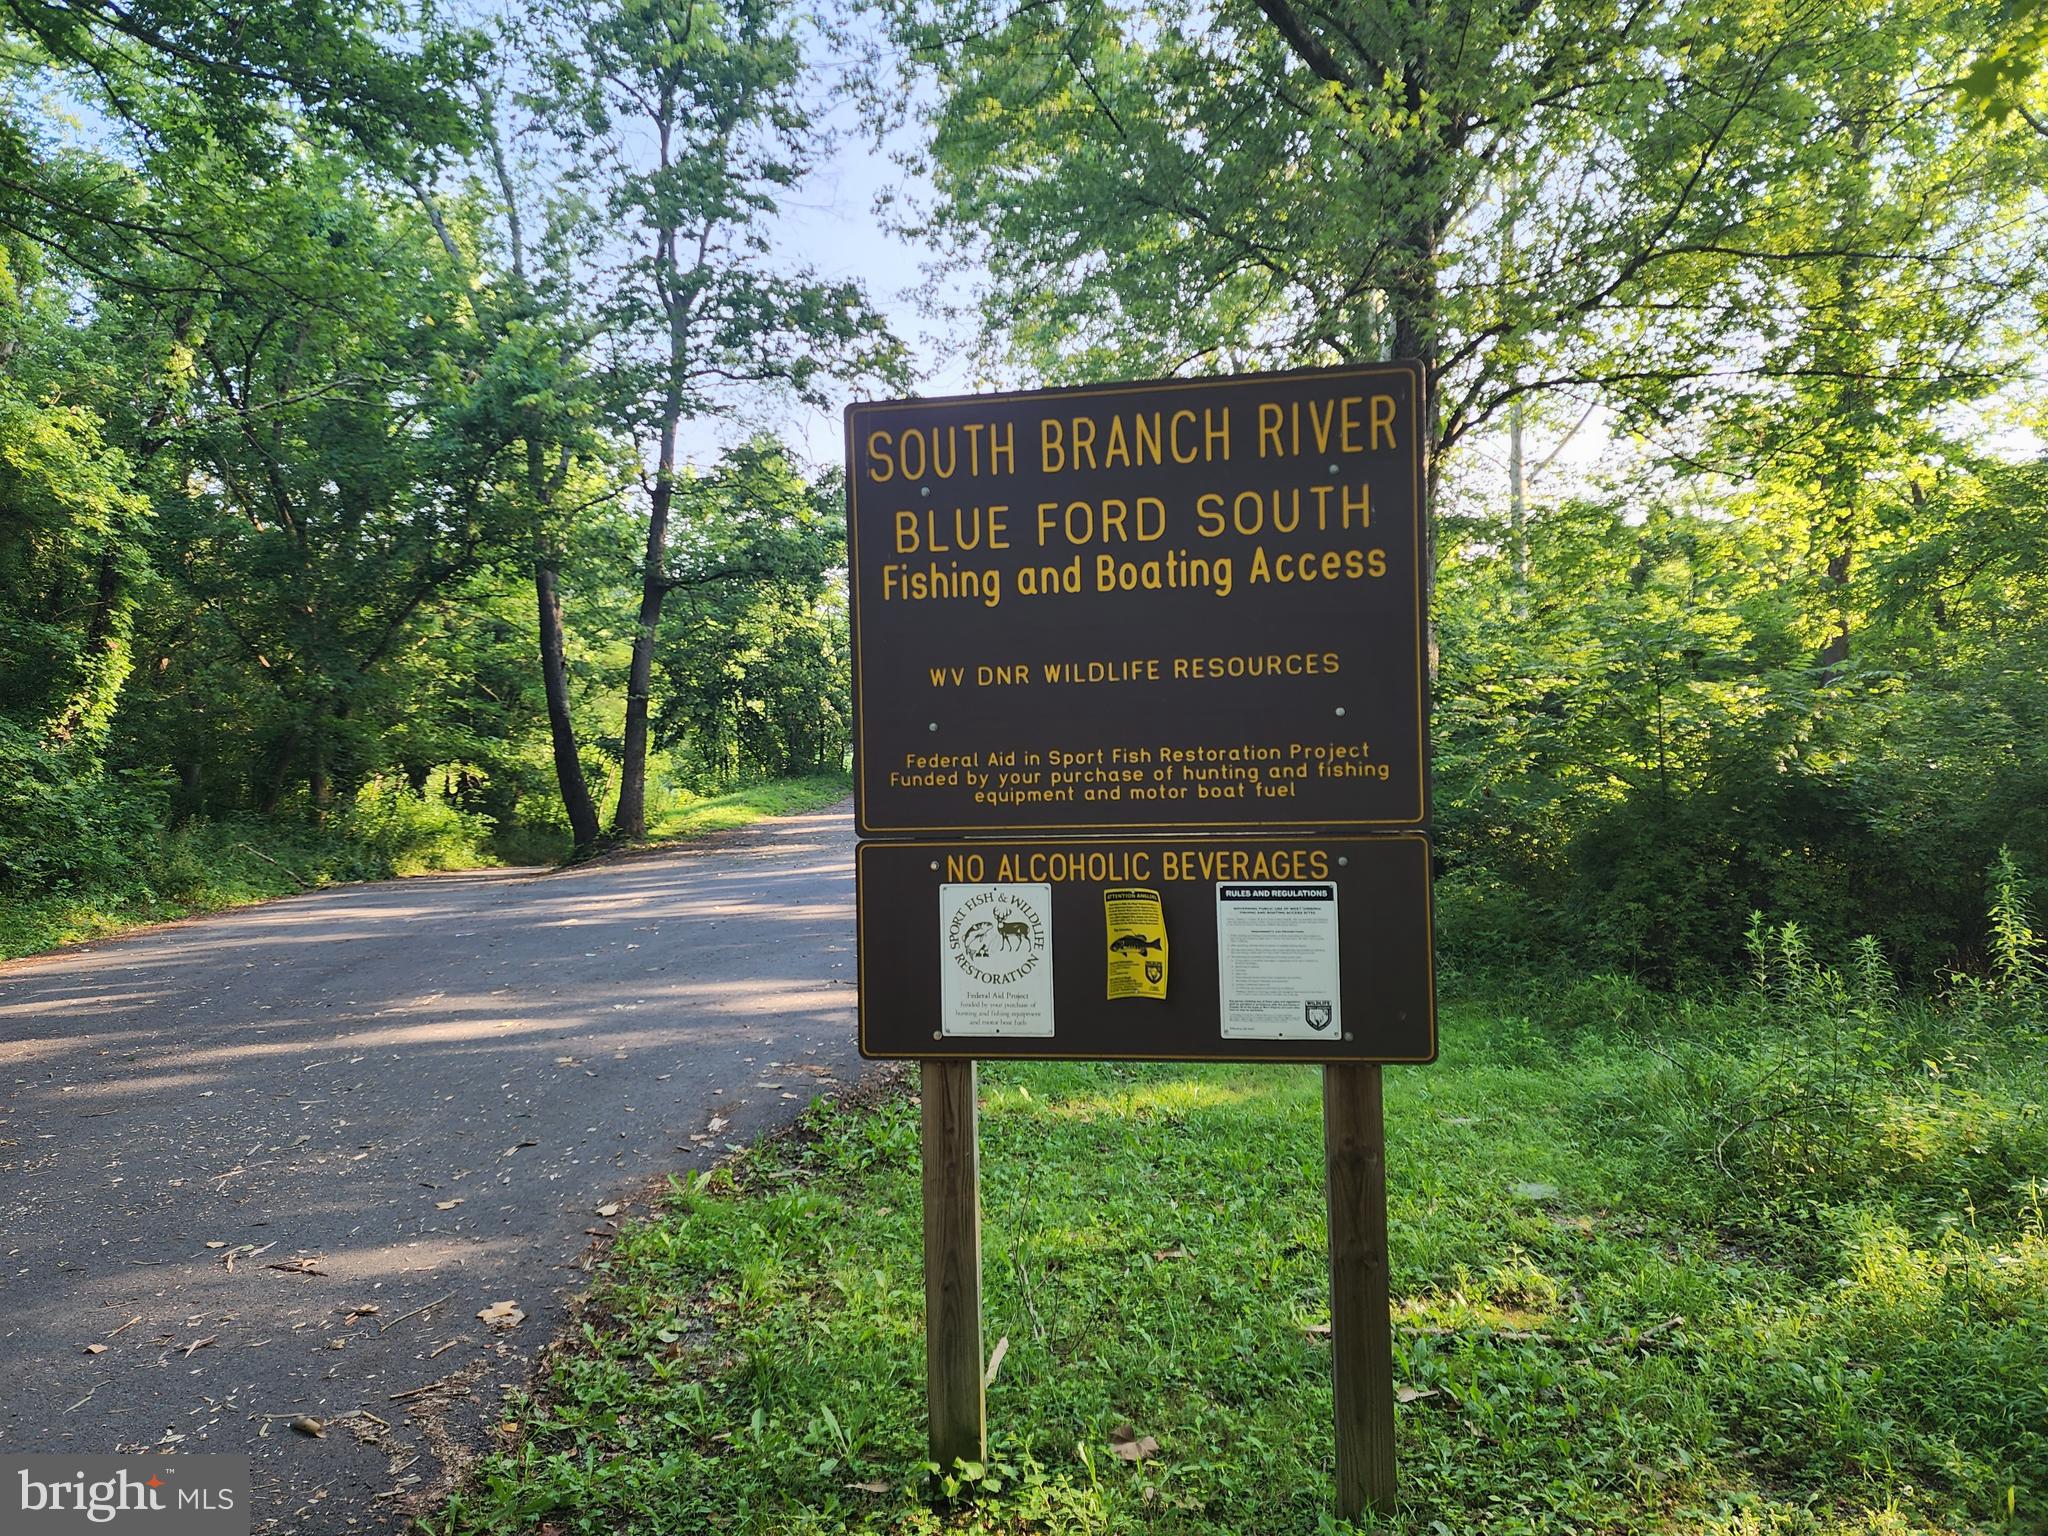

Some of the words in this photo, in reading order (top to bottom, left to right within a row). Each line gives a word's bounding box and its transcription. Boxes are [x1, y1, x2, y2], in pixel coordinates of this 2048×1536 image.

[867, 422, 1016, 483] SOUTH
[1040, 405, 1231, 474] BRANCH
[1257, 393, 1398, 459] RIVER
[894, 505, 1011, 554] BLUE
[1036, 496, 1167, 547] FORD
[1196, 483, 1372, 538] SOUTH
[882, 561, 1002, 608] Fishing
[1016, 554, 1082, 597] and
[1097, 548, 1233, 597] Boating
[1249, 545, 1388, 584] Access
[929, 667, 966, 688] WV
[976, 664, 1030, 686] DNR
[1043, 659, 1161, 684] WILDLIFE
[1173, 652, 1342, 680] RESOURCES
[905, 751, 979, 769] Federal
[987, 750, 1015, 768] Aid
[1022, 750, 1041, 767] in
[1048, 748, 1104, 769] Sport
[1111, 747, 1152, 765] Fish
[1159, 744, 1282, 763] Restoration
[1290, 741, 1370, 763] Project
[890, 770, 959, 788] Funded
[966, 769, 989, 790] by
[998, 771, 1042, 789] your
[1049, 767, 1146, 788] purchase
[1152, 764, 1176, 784] of
[1182, 763, 1260, 784] hunting
[1268, 762, 1309, 780] and
[1317, 760, 1390, 781] fishing
[973, 786, 1075, 806] equipment
[1083, 783, 1122, 801] and
[1129, 782, 1188, 800] motor
[1196, 780, 1246, 799] boat
[1255, 778, 1296, 798] fuel
[947, 854, 986, 882] NO
[997, 851, 1151, 883] ALCOHOLIC
[1162, 850, 1330, 881] BEVERAGES
[1225, 889, 1252, 898] RULES
[1252, 889, 1270, 898] AND
[1271, 889, 1328, 898] REGULATIONS
[949, 908, 966, 950] SPORT
[964, 892, 994, 911] FISH
[997, 892, 1008, 903] &
[1010, 894, 1045, 951] WILDLIFE
[954, 952, 1039, 985] RESTORATION
[967, 991, 991, 999] Federal
[992, 991, 1005, 999] Aid
[1006, 991, 1029, 1001] Project
